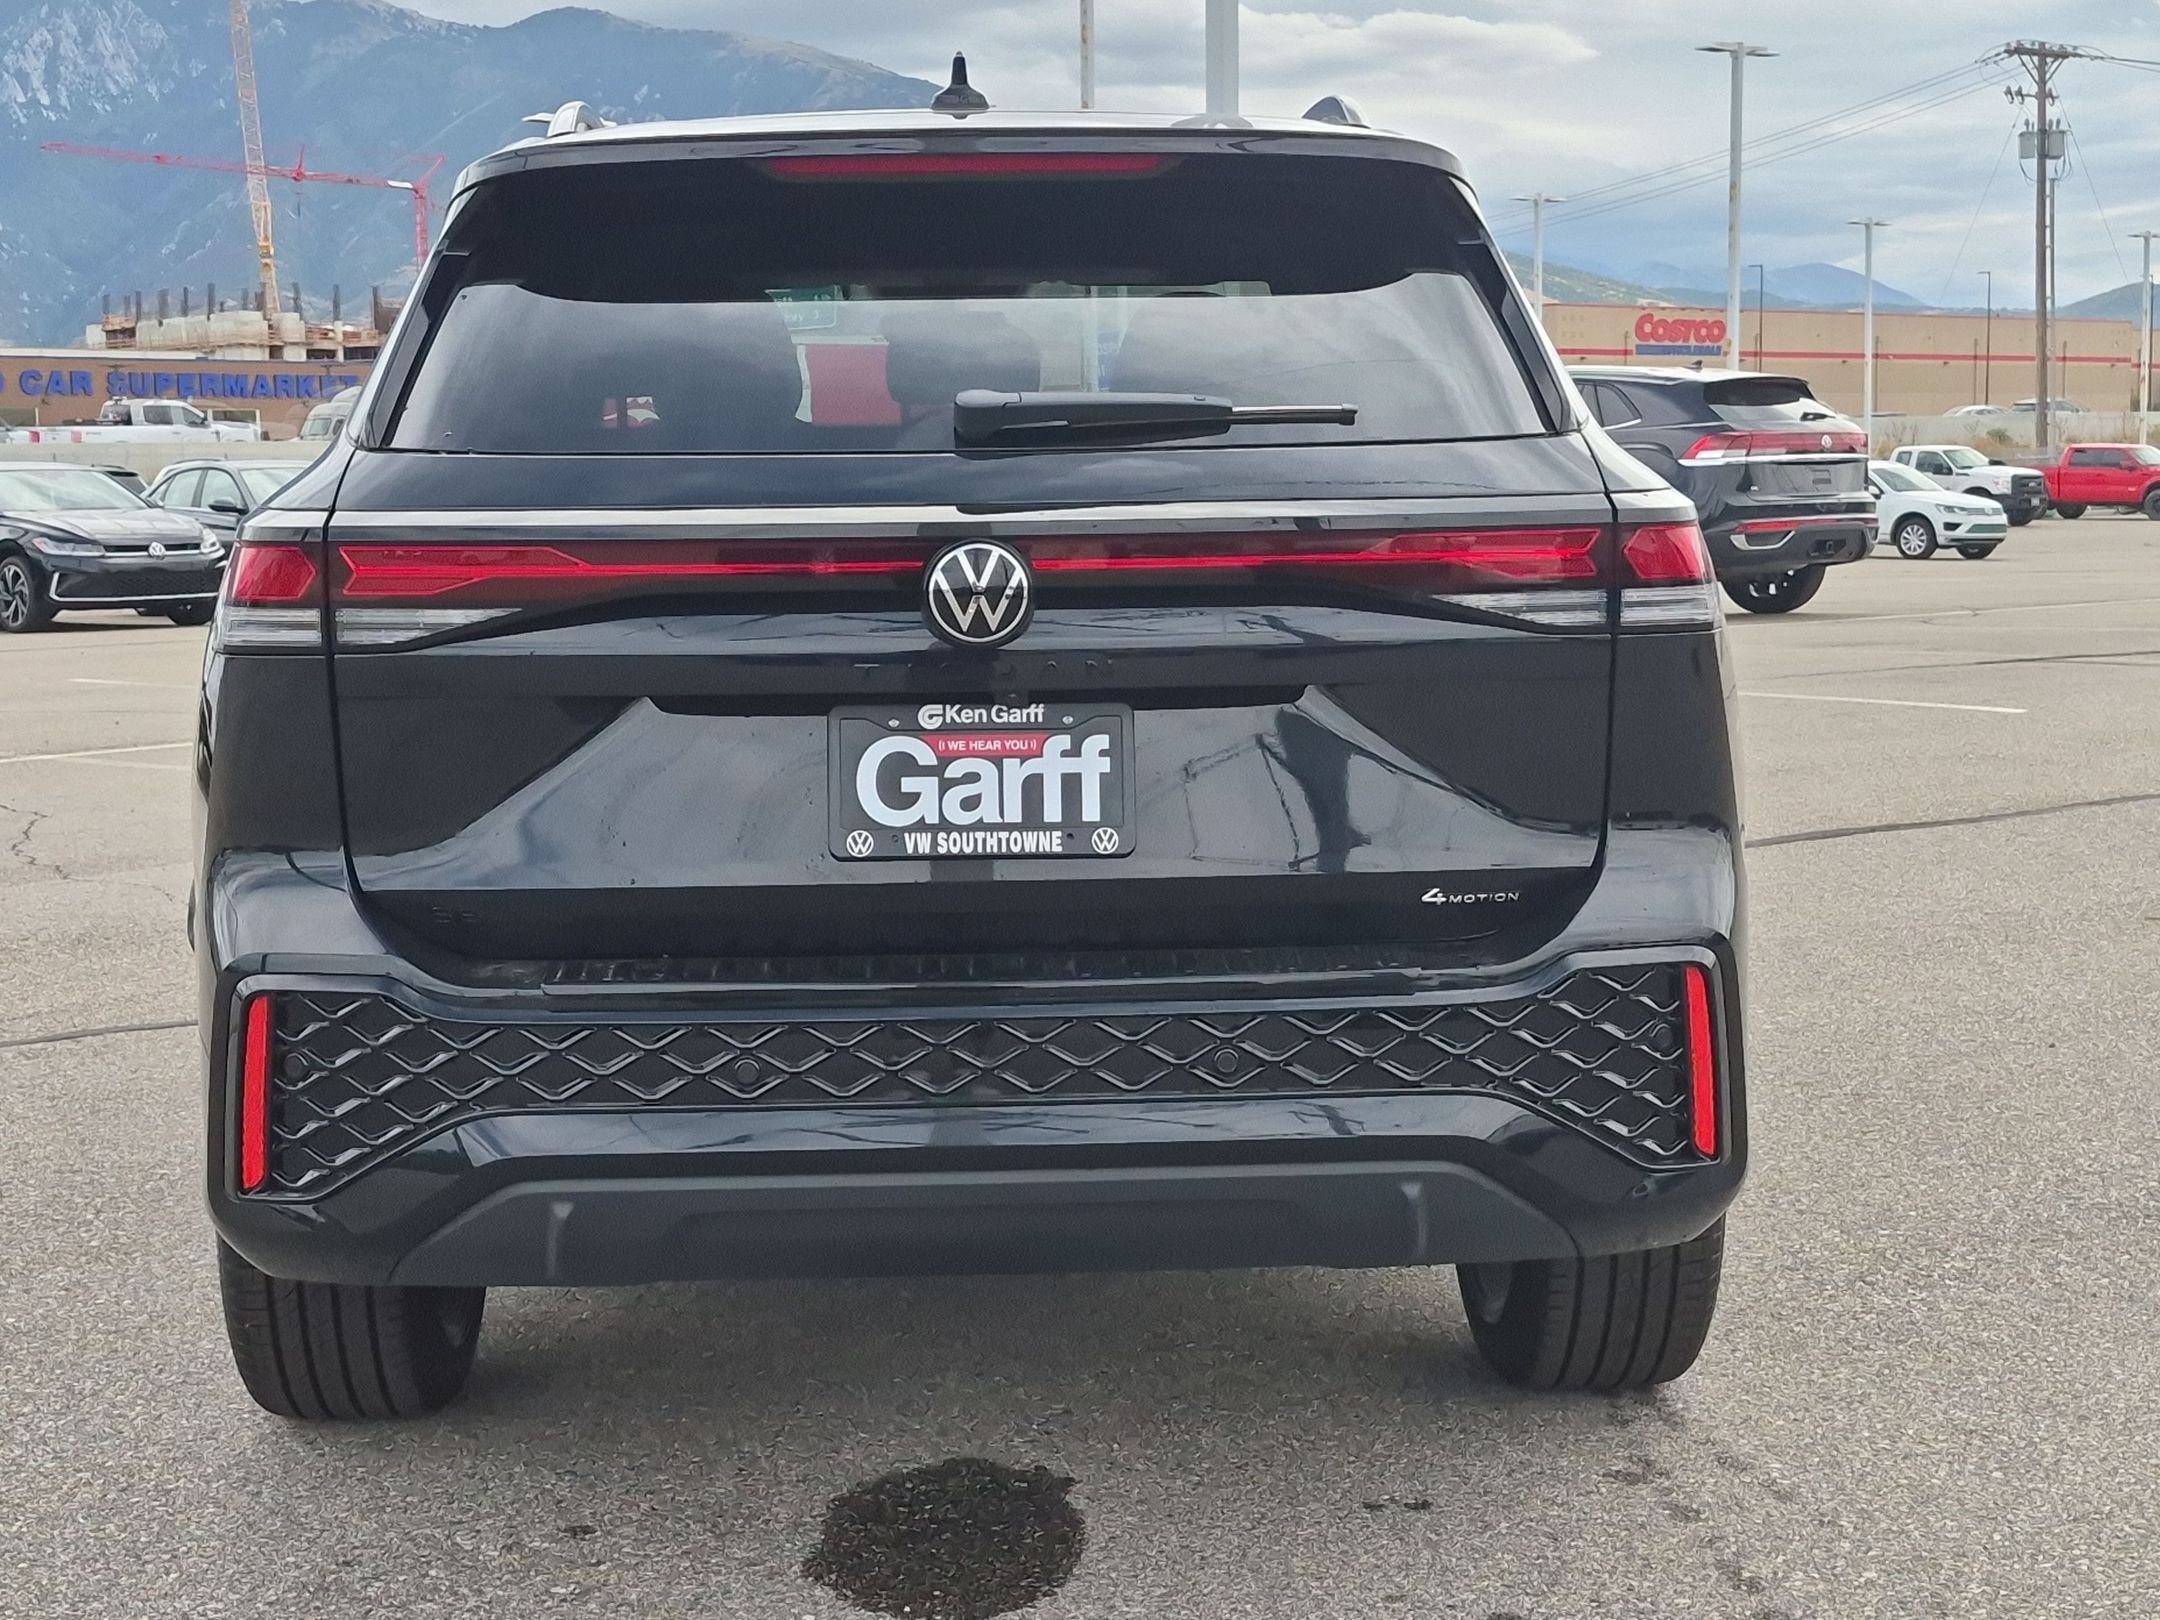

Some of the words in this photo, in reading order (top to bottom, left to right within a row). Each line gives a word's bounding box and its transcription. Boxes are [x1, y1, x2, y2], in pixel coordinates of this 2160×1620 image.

[1635, 312, 1727, 344] COSTCO
[19, 369, 94, 396] CAR
[945, 704, 987, 723] Ken
[991, 703, 1045, 723] Garff
[948, 741, 967, 751] WE
[969, 741, 1002, 751] HEAR
[1004, 740, 1028, 750] YOU
[856, 734, 1111, 828] Garff
[904, 832, 932, 854] VW
[937, 831, 1063, 854] SOUTHTOWNE
